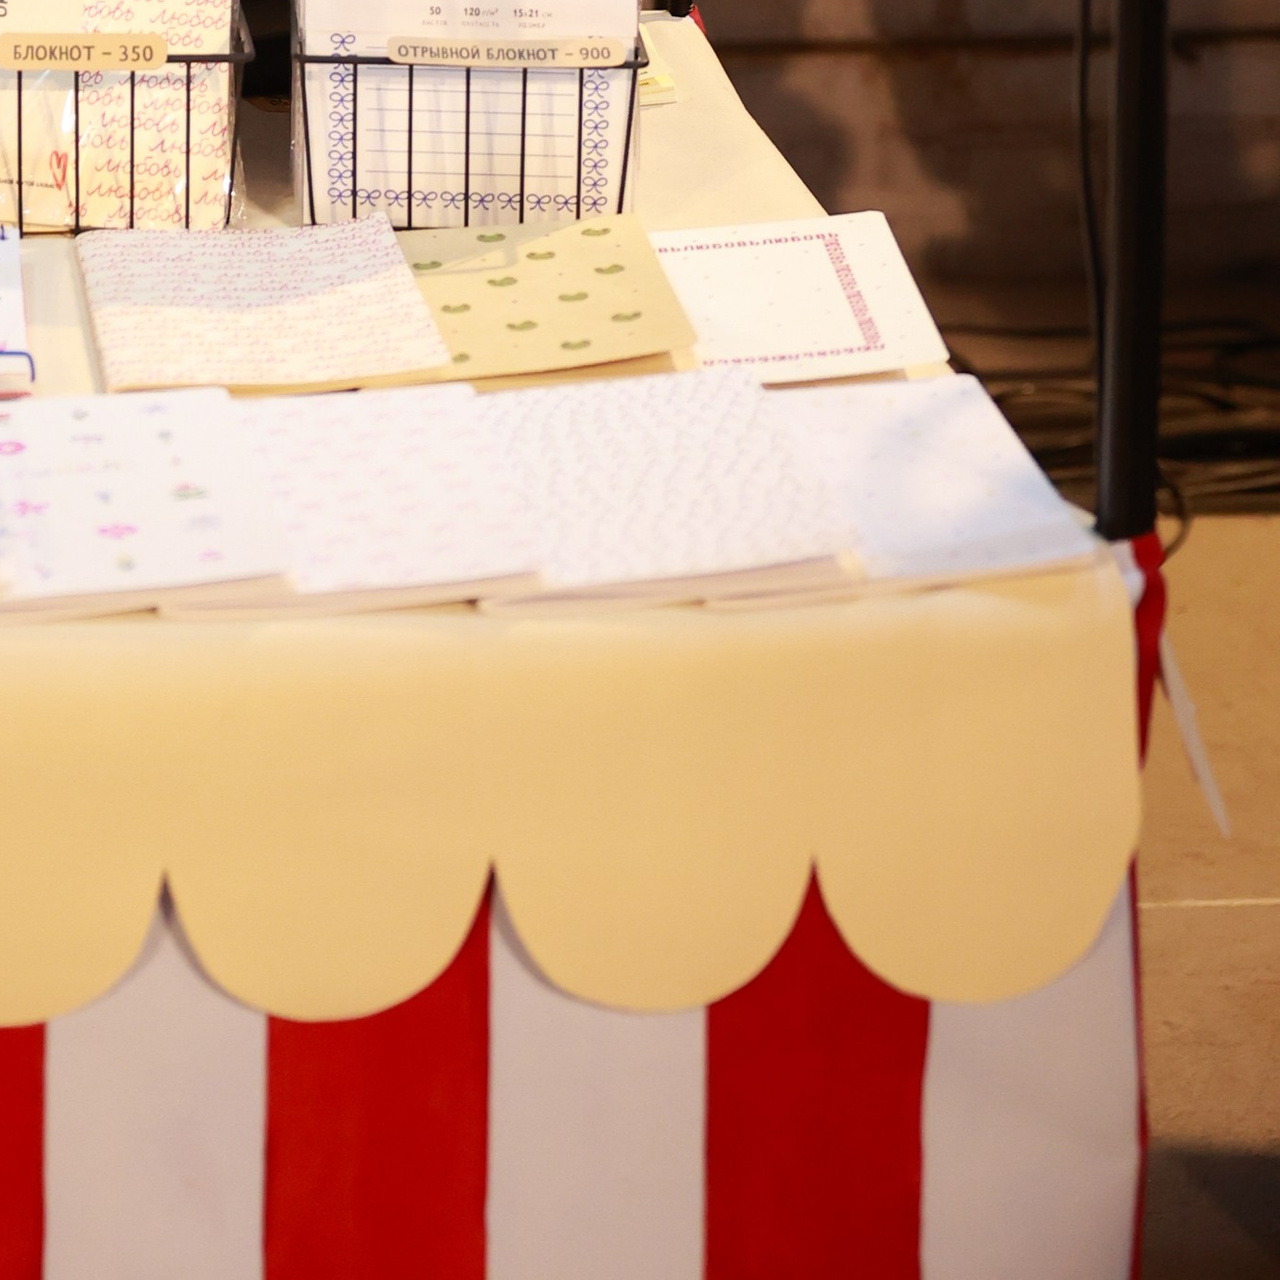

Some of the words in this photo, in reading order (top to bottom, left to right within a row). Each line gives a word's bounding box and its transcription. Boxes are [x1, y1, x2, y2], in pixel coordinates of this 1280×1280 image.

[429, 5, 442, 16] 50
[463, 6, 481, 17] 120
[12, 44, 96, 62] БЛОКНОТ
[119, 45, 154, 62] 350
[397, 43, 480, 60] ОТРЫВНОЙ
[485, 46, 559, 62] БЛОКНОТ
[578, 46, 612, 61] 900
